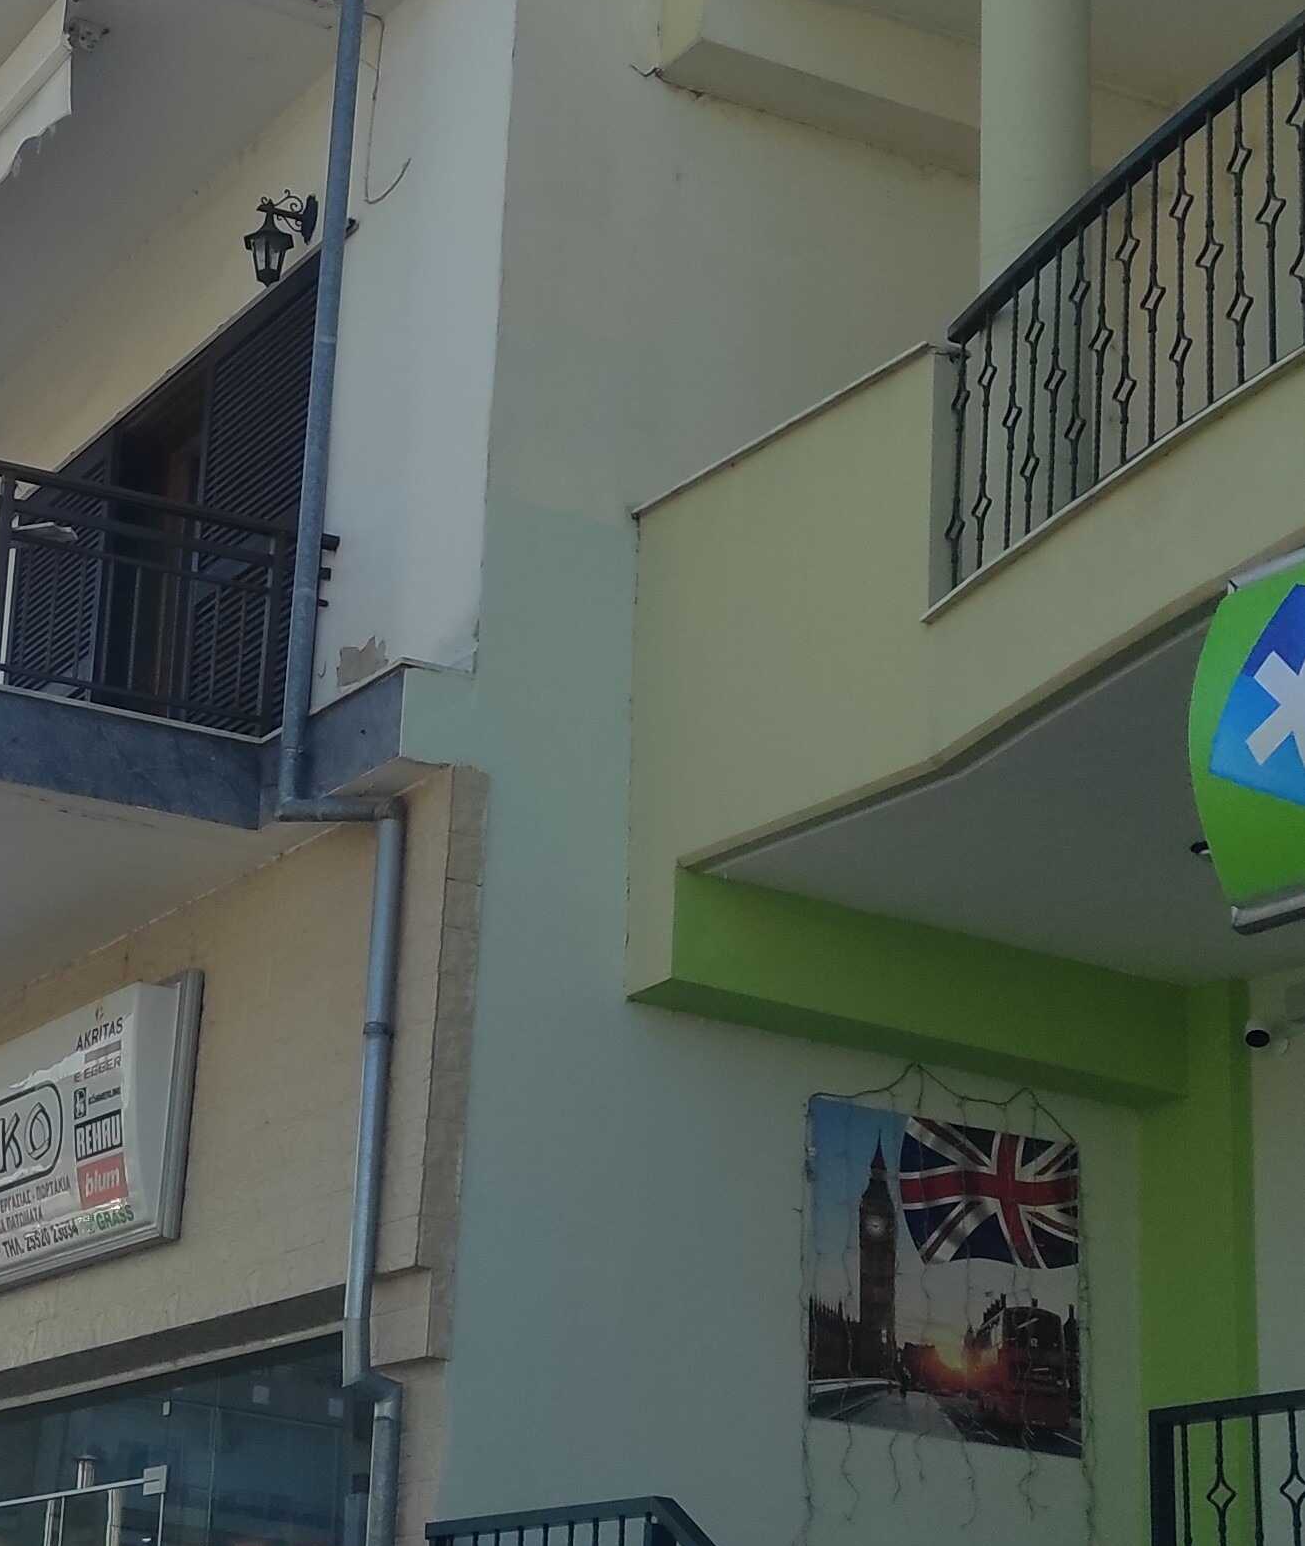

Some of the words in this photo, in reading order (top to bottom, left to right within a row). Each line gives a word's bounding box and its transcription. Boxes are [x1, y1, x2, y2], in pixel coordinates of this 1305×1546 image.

[75, 1017, 124, 1052] AKRITAS
[84, 1056, 122, 1080] EGGER
[76, 1113, 122, 1158] REHAU
[85, 1166, 120, 1198] blum
[96, 1205, 135, 1231] GRASS
